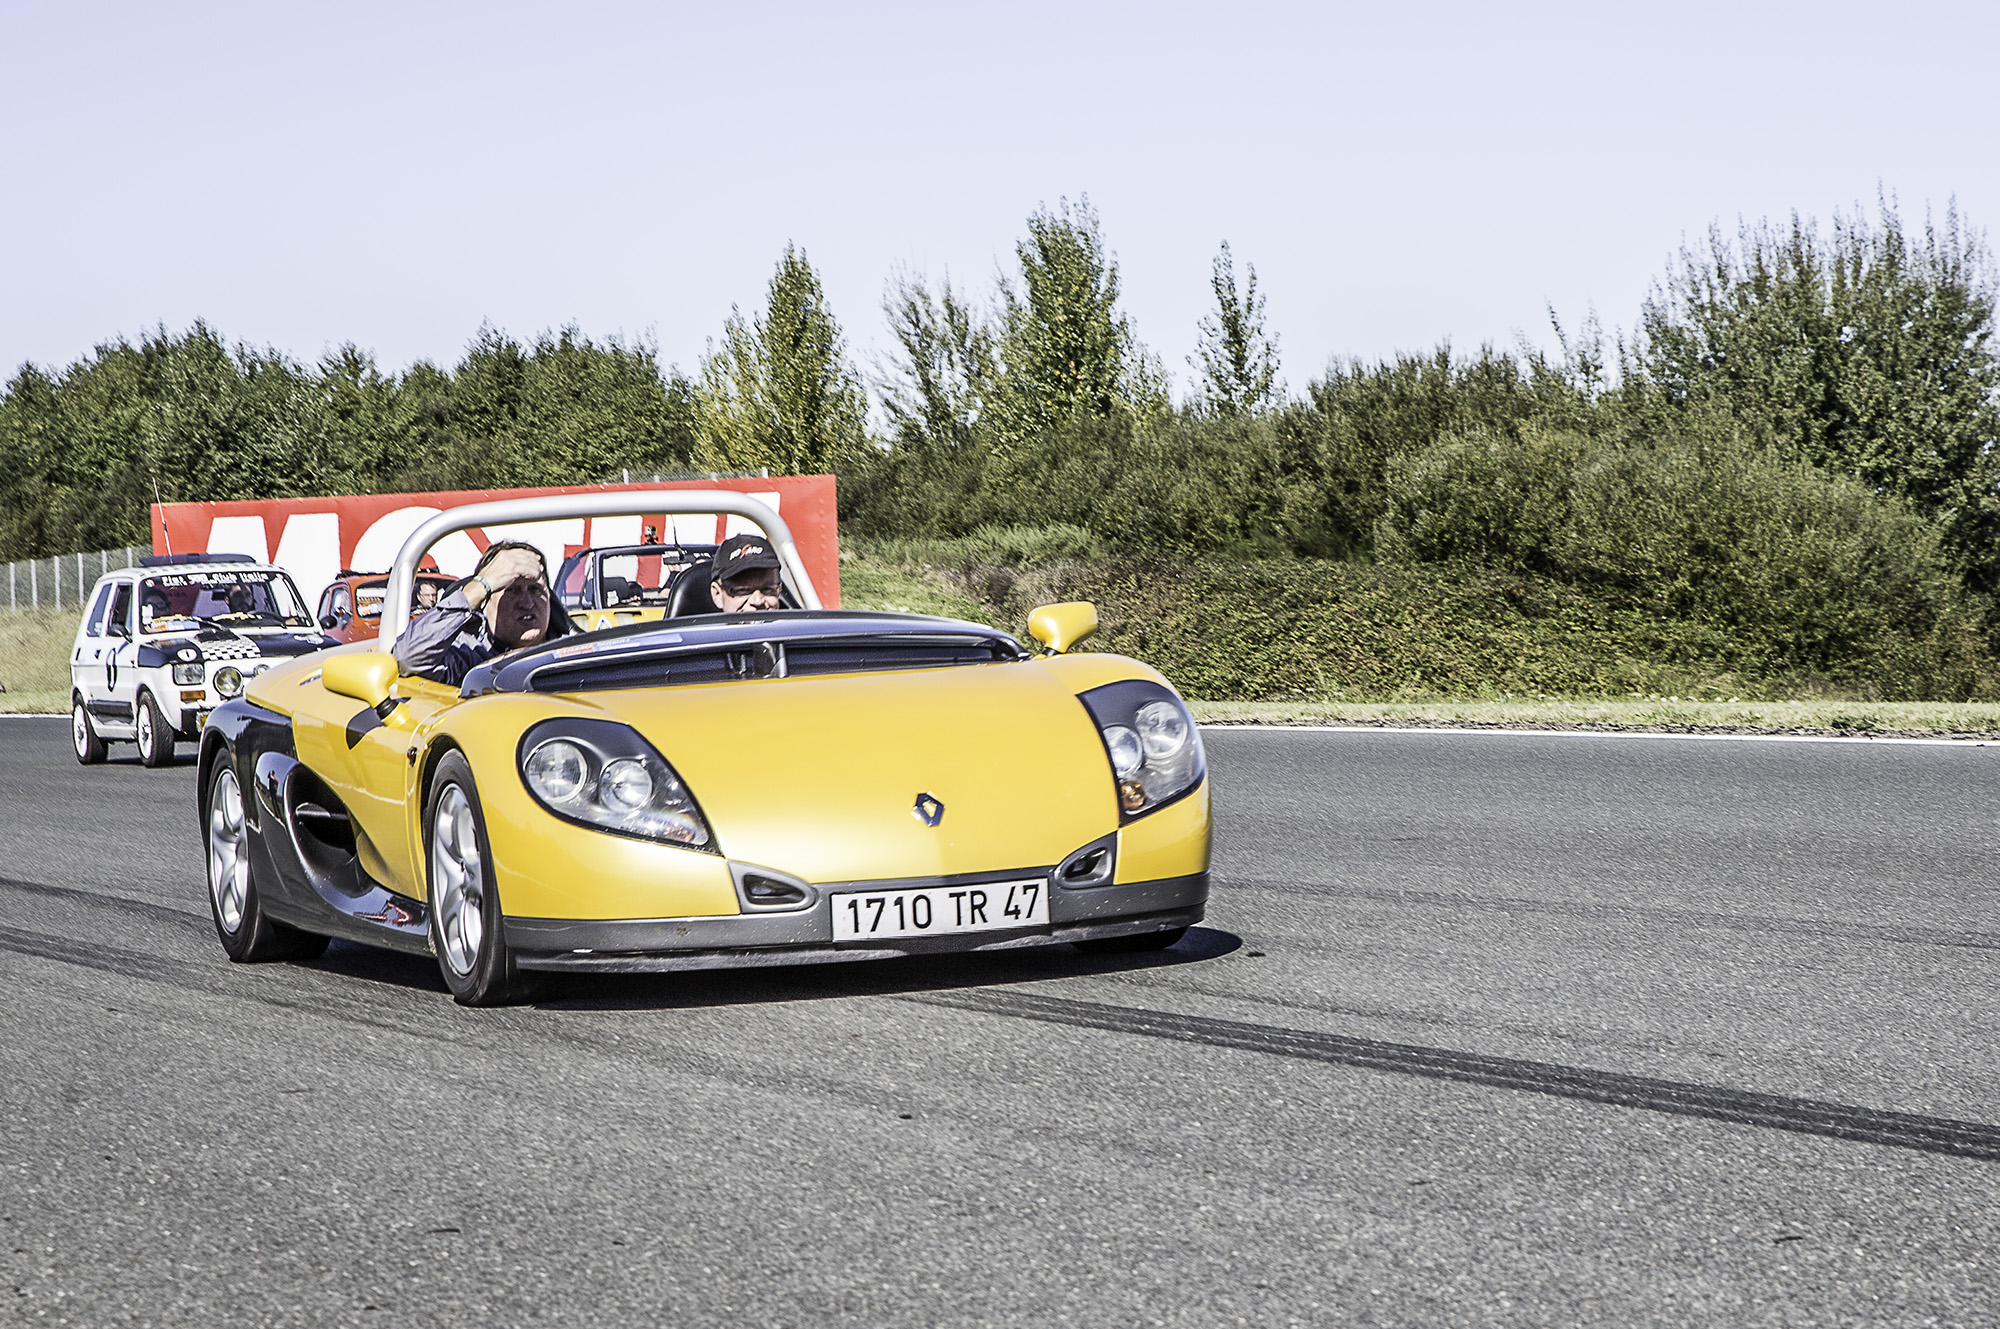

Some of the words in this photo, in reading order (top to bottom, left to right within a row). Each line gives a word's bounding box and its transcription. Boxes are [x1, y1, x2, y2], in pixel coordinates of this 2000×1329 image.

[848, 894, 932, 933] 1710
[949, 889, 987, 926] TR
[1004, 884, 1039, 919] 47
